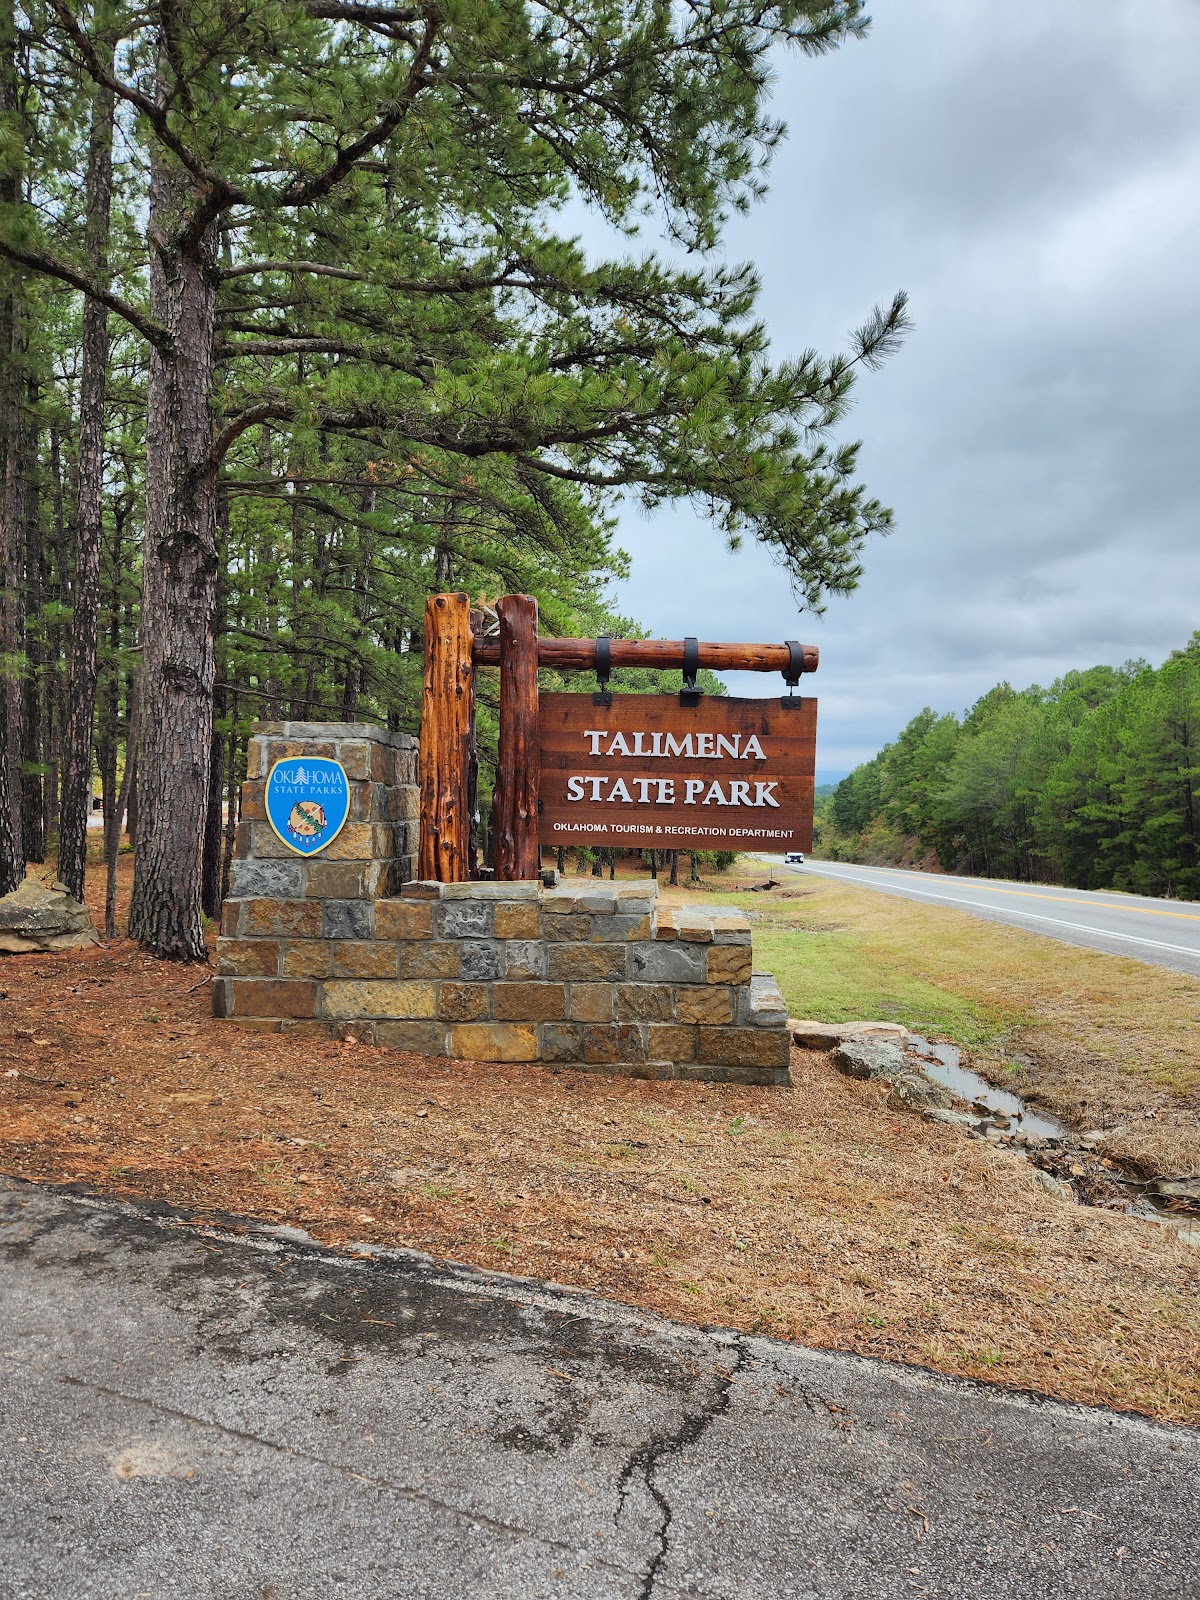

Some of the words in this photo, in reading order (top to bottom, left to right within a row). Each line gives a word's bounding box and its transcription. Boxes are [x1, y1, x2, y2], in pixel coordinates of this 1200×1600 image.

[584, 730, 767, 760] TALIMENA
[274, 786, 305, 794] STATE
[310, 786, 343, 795] PARKS
[567, 776, 675, 804] STATE
[684, 779, 780, 808] PARK
[553, 822, 608, 833] OKLAHOMA
[610, 824, 654, 834] TOURISM
[655, 825, 663, 835] &
[664, 826, 727, 836] RECREATION
[729, 828, 794, 838] DEPARTMENT
